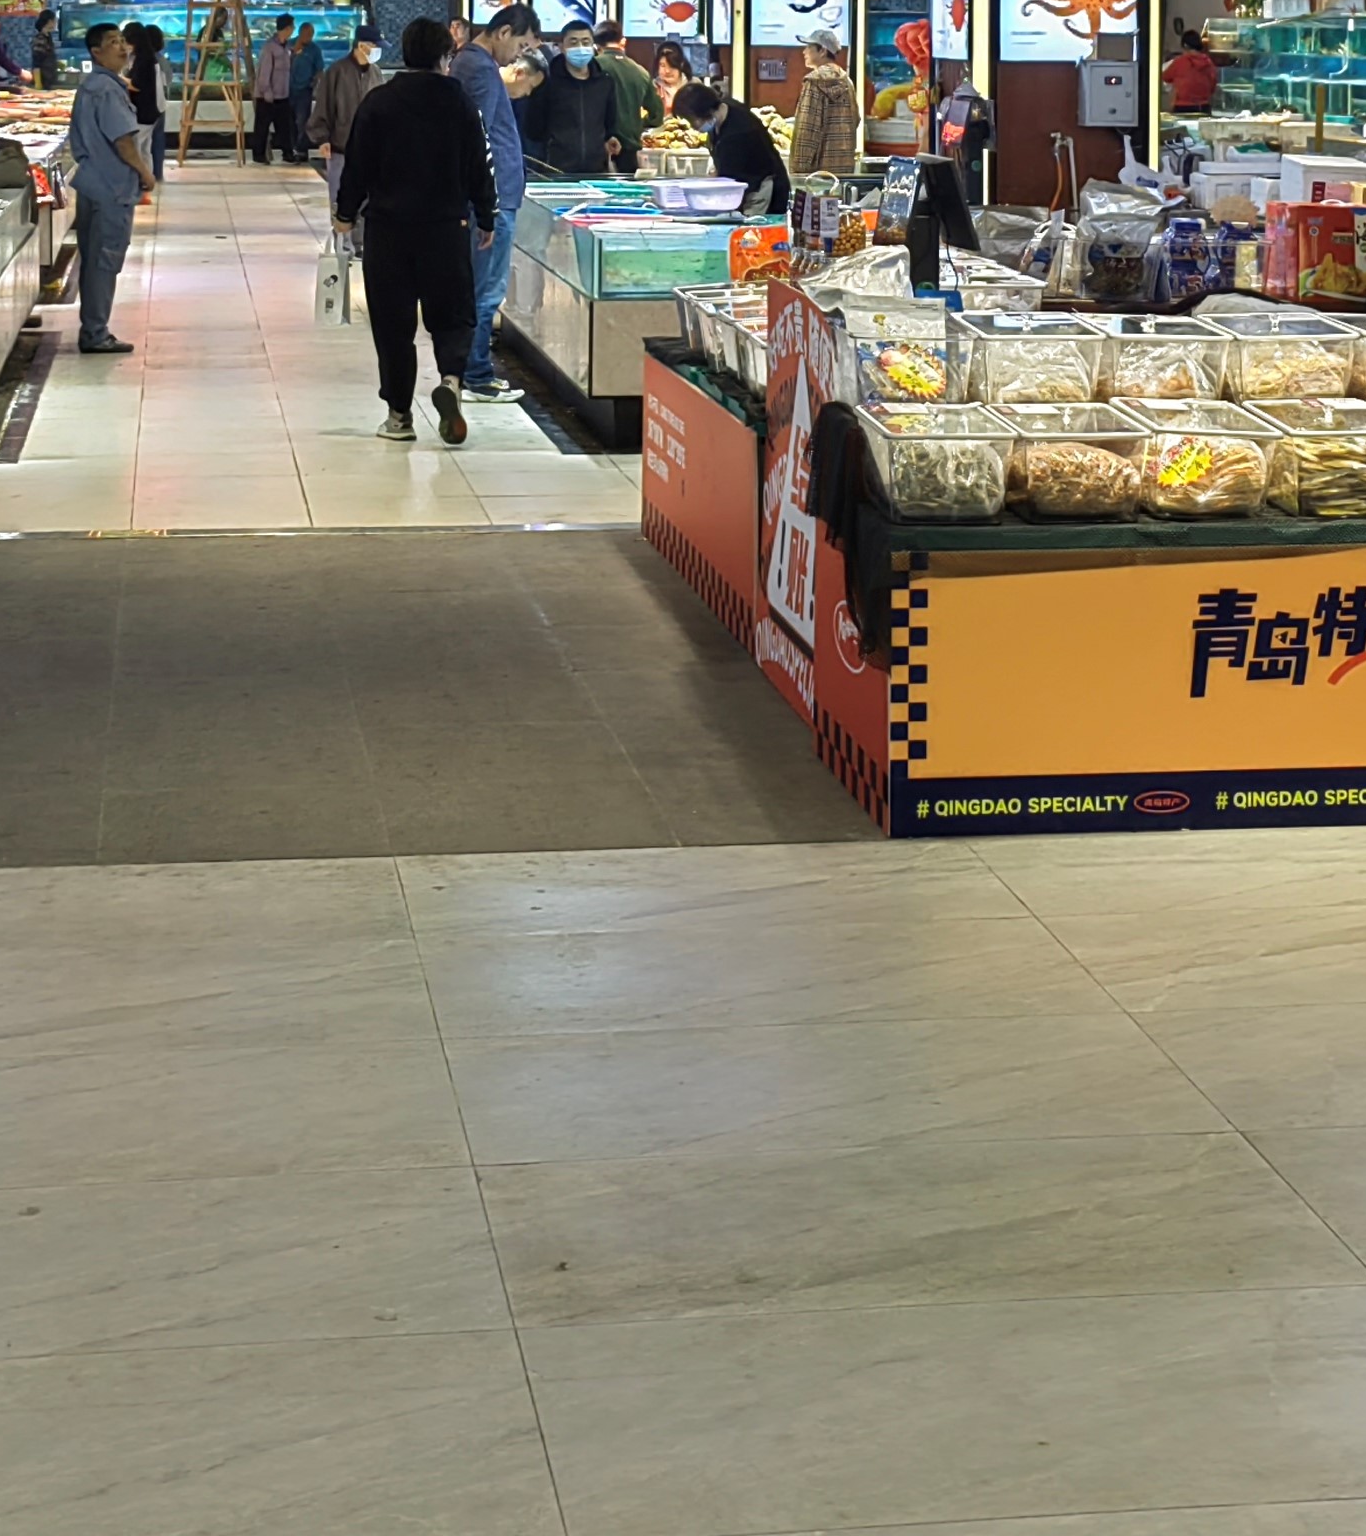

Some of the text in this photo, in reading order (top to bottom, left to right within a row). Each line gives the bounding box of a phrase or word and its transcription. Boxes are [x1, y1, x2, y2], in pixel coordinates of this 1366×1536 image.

[934, 797, 1023, 817] QINGDAO
[1027, 795, 1129, 814] SPECIALTY
[1232, 789, 1319, 808] QINGDAO
